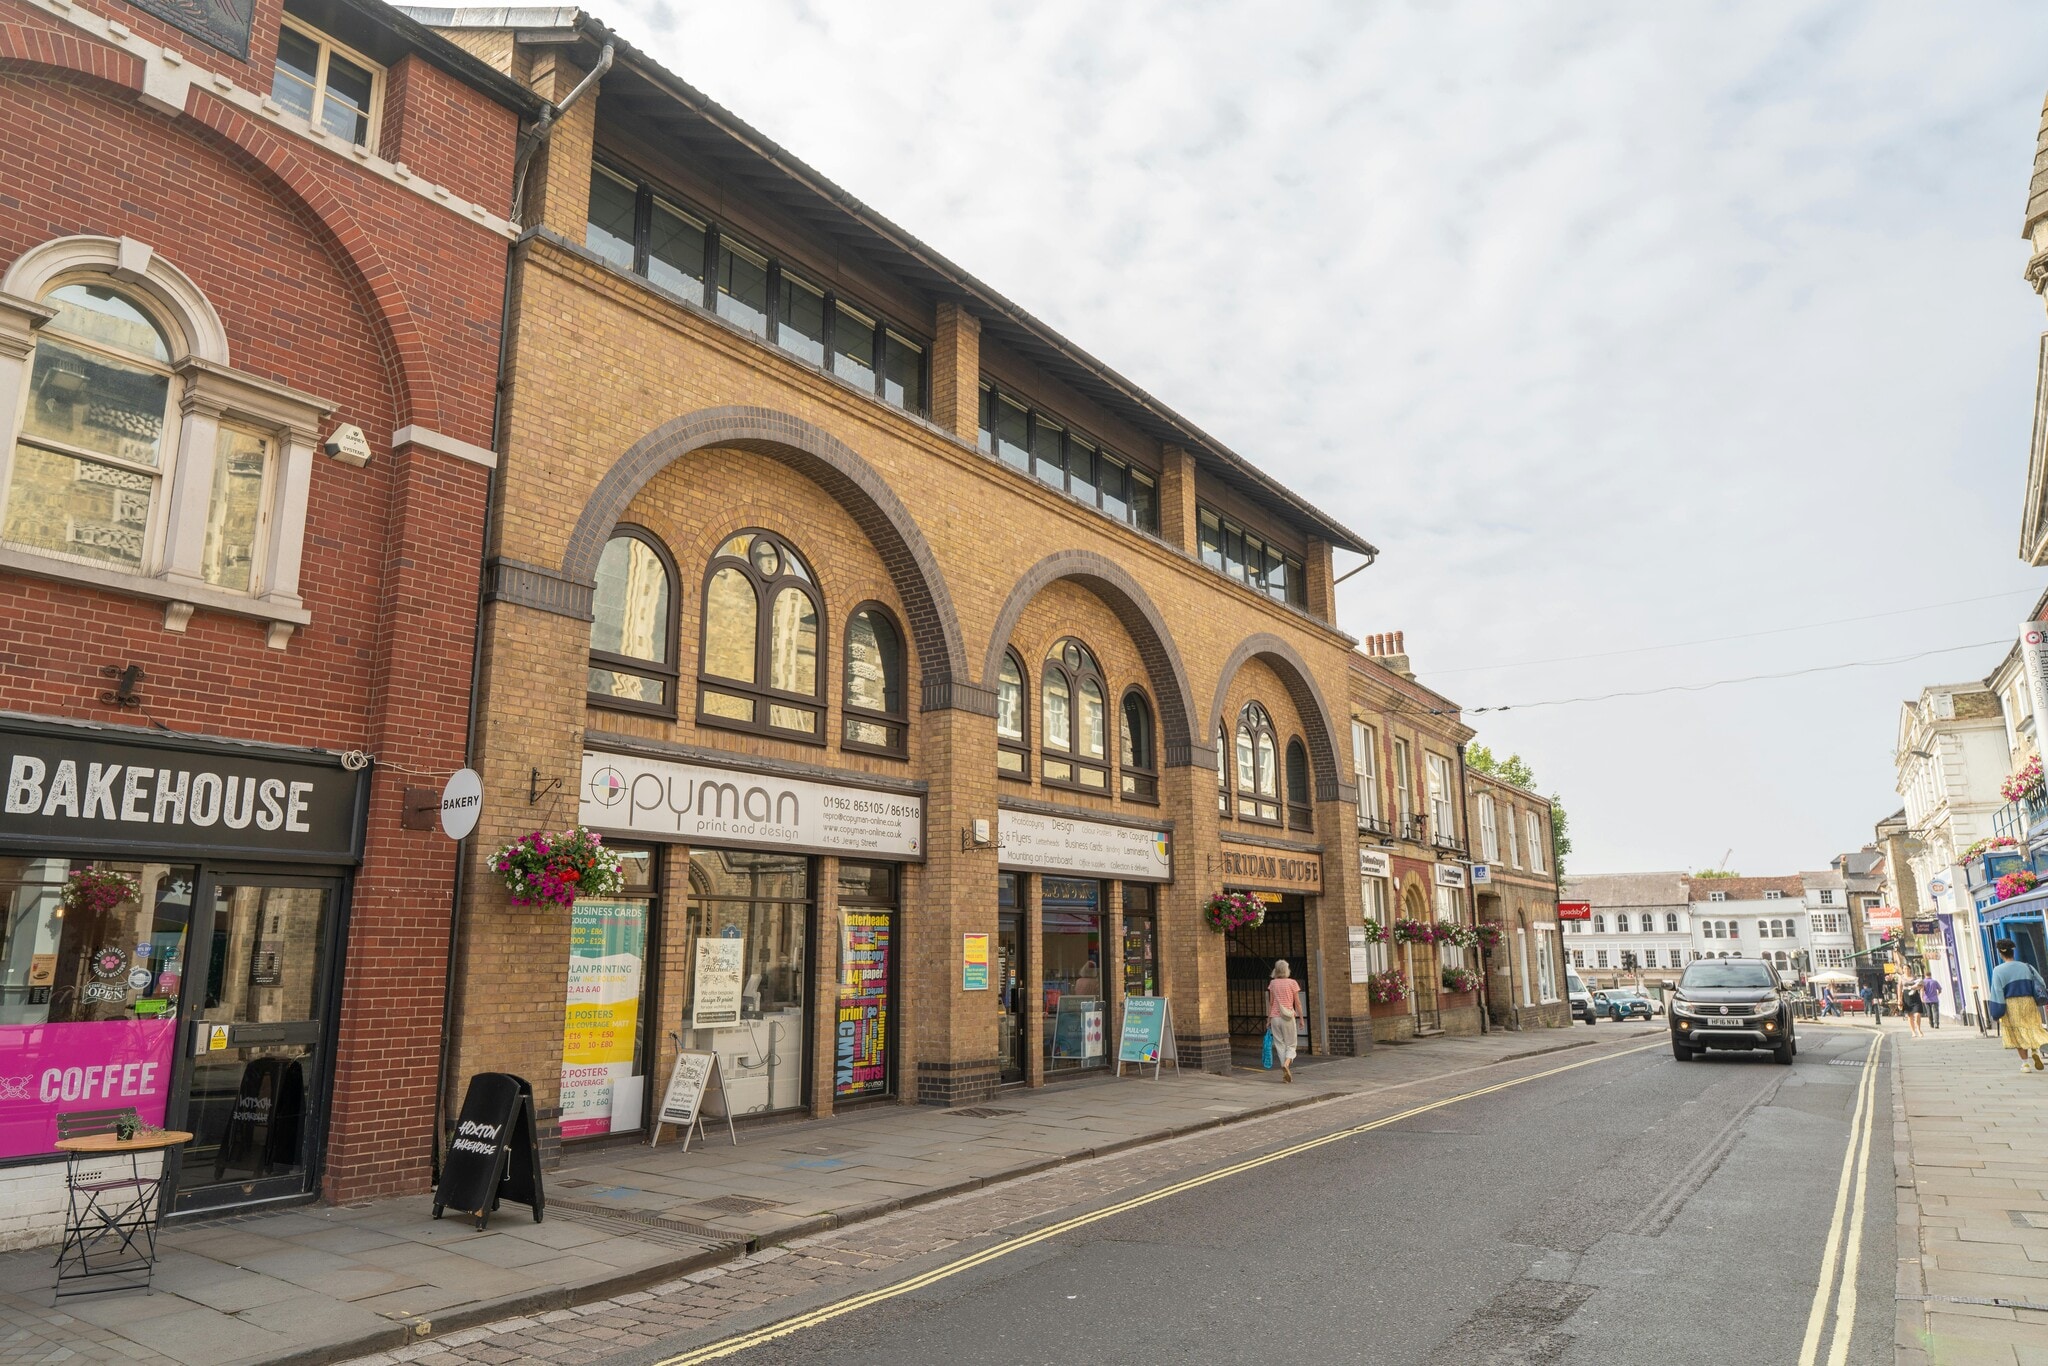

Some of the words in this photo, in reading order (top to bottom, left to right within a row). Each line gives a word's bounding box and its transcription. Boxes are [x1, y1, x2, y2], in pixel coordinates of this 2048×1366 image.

[2029, 650, 2039, 677] County
[2034, 681, 2047, 709] Council
[5, 755, 314, 832] BAKEHOUSE
[443, 795, 479, 810] BAKERY
[823, 796, 850, 810] 01962
[854, 800, 883, 814] 863105
[891, 805, 919, 818] 861518
[697, 820, 726, 832] print
[732, 823, 755, 834] and
[760, 825, 798, 841] design
[823, 824, 901, 838] www.copyman-online.co.uk
[1012, 817, 1044, 830] Photocopying
[1052, 819, 1074, 835] Design
[1117, 830, 1128, 838] Plan
[1129, 832, 1148, 844] Copying
[842, 837, 859, 848] Jewry
[861, 839, 877, 847] Street
[1012, 830, 1031, 846] Flyers
[1065, 839, 1088, 850] Business
[1090, 842, 1102, 852] Cards
[1124, 847, 1149, 859] Laminating
[1008, 851, 1033, 864] Mounting
[1035, 854, 1043, 862] on
[1044, 853, 1073, 865] foamboard
[1111, 862, 1130, 871] Collection
[1134, 864, 1149, 874] delivery
[1221, 851, 1276, 878] ERIDAN
[1279, 858, 1318, 882] HOUSE
[572, 906, 612, 916] BUSINESS
[614, 908, 642, 918] CARDS
[1560, 908, 1583, 916] goadsby
[845, 914, 890, 926] letterheads
[109, 947, 126, 959] LEGGED
[847, 950, 884, 962] photocopy
[109, 961, 126, 977] WELCOME
[591, 965, 632, 974] PRINTING
[847, 970, 859, 984] A4
[863, 969, 883, 980] paper
[88, 988, 123, 999] OPEN
[575, 1010, 614, 1019] POSTERS
[840, 1006, 863, 1022] print
[877, 1011, 886, 1050] binding
[854, 1020, 862, 1058] design
[837, 1021, 855, 1085] CMYK
[569, 1068, 608, 1078] POSTERS
[39, 1062, 158, 1103] COFFEE
[571, 1079, 604, 1087] COVERAGE
[563, 1091, 576, 1099] £12
[562, 1101, 574, 1109] £22
[459, 1120, 502, 1139] HOXTON
[453, 1139, 496, 1154] BAKEHOUSE
